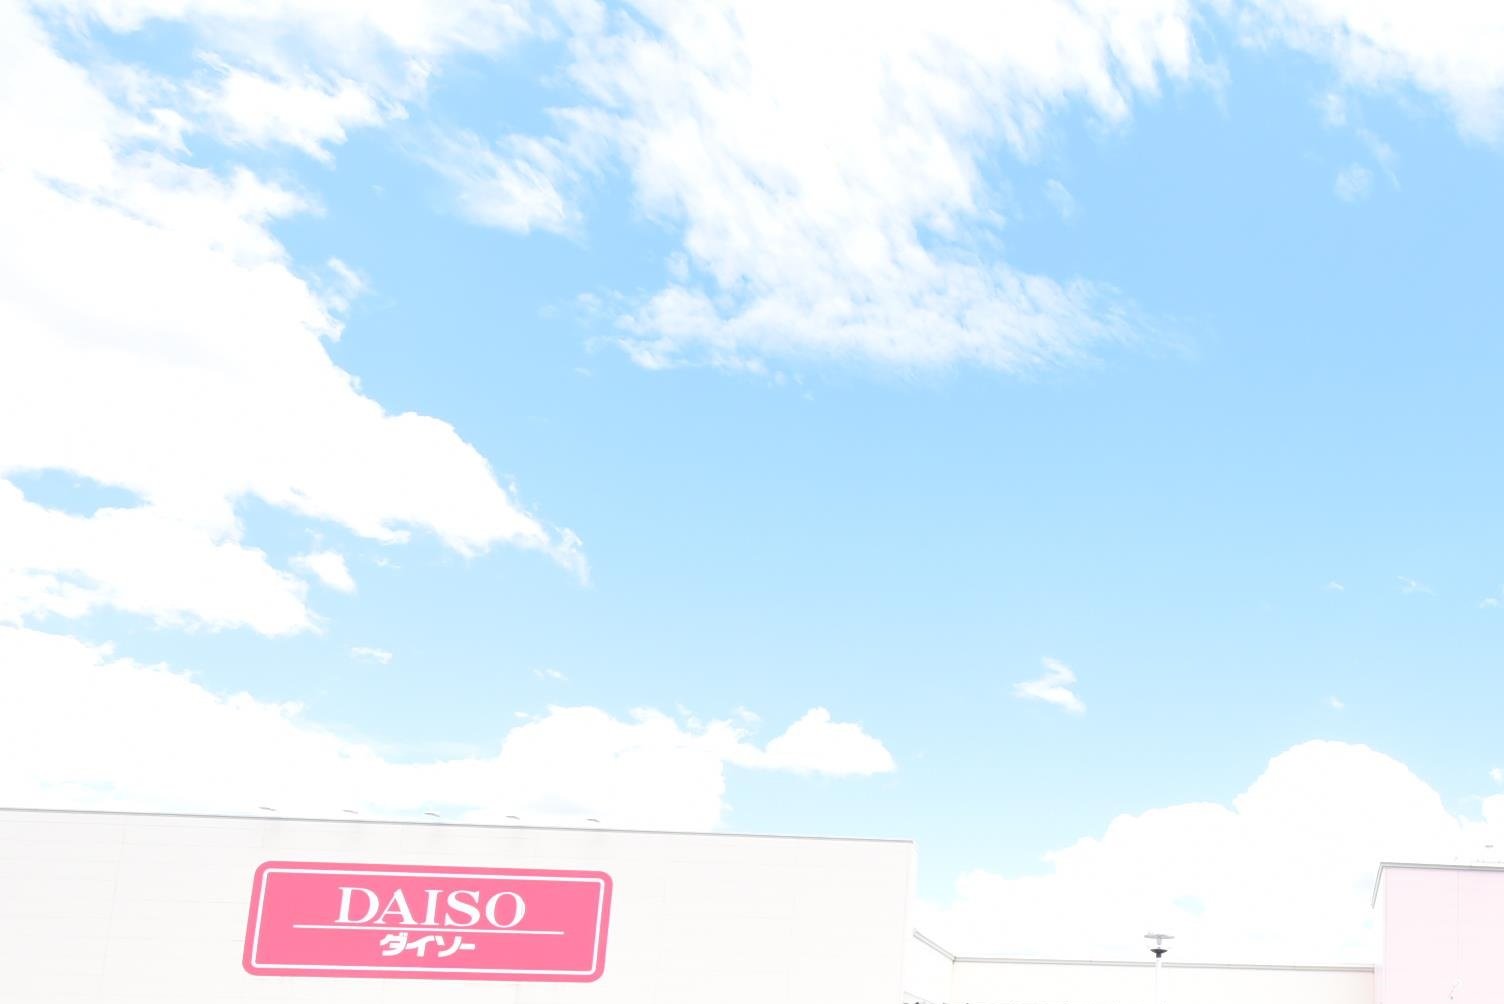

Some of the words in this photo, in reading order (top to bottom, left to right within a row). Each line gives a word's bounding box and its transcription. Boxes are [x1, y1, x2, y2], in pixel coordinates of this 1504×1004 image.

[334, 886, 526, 928] DAISO
[379, 932, 476, 958] ダイソー
